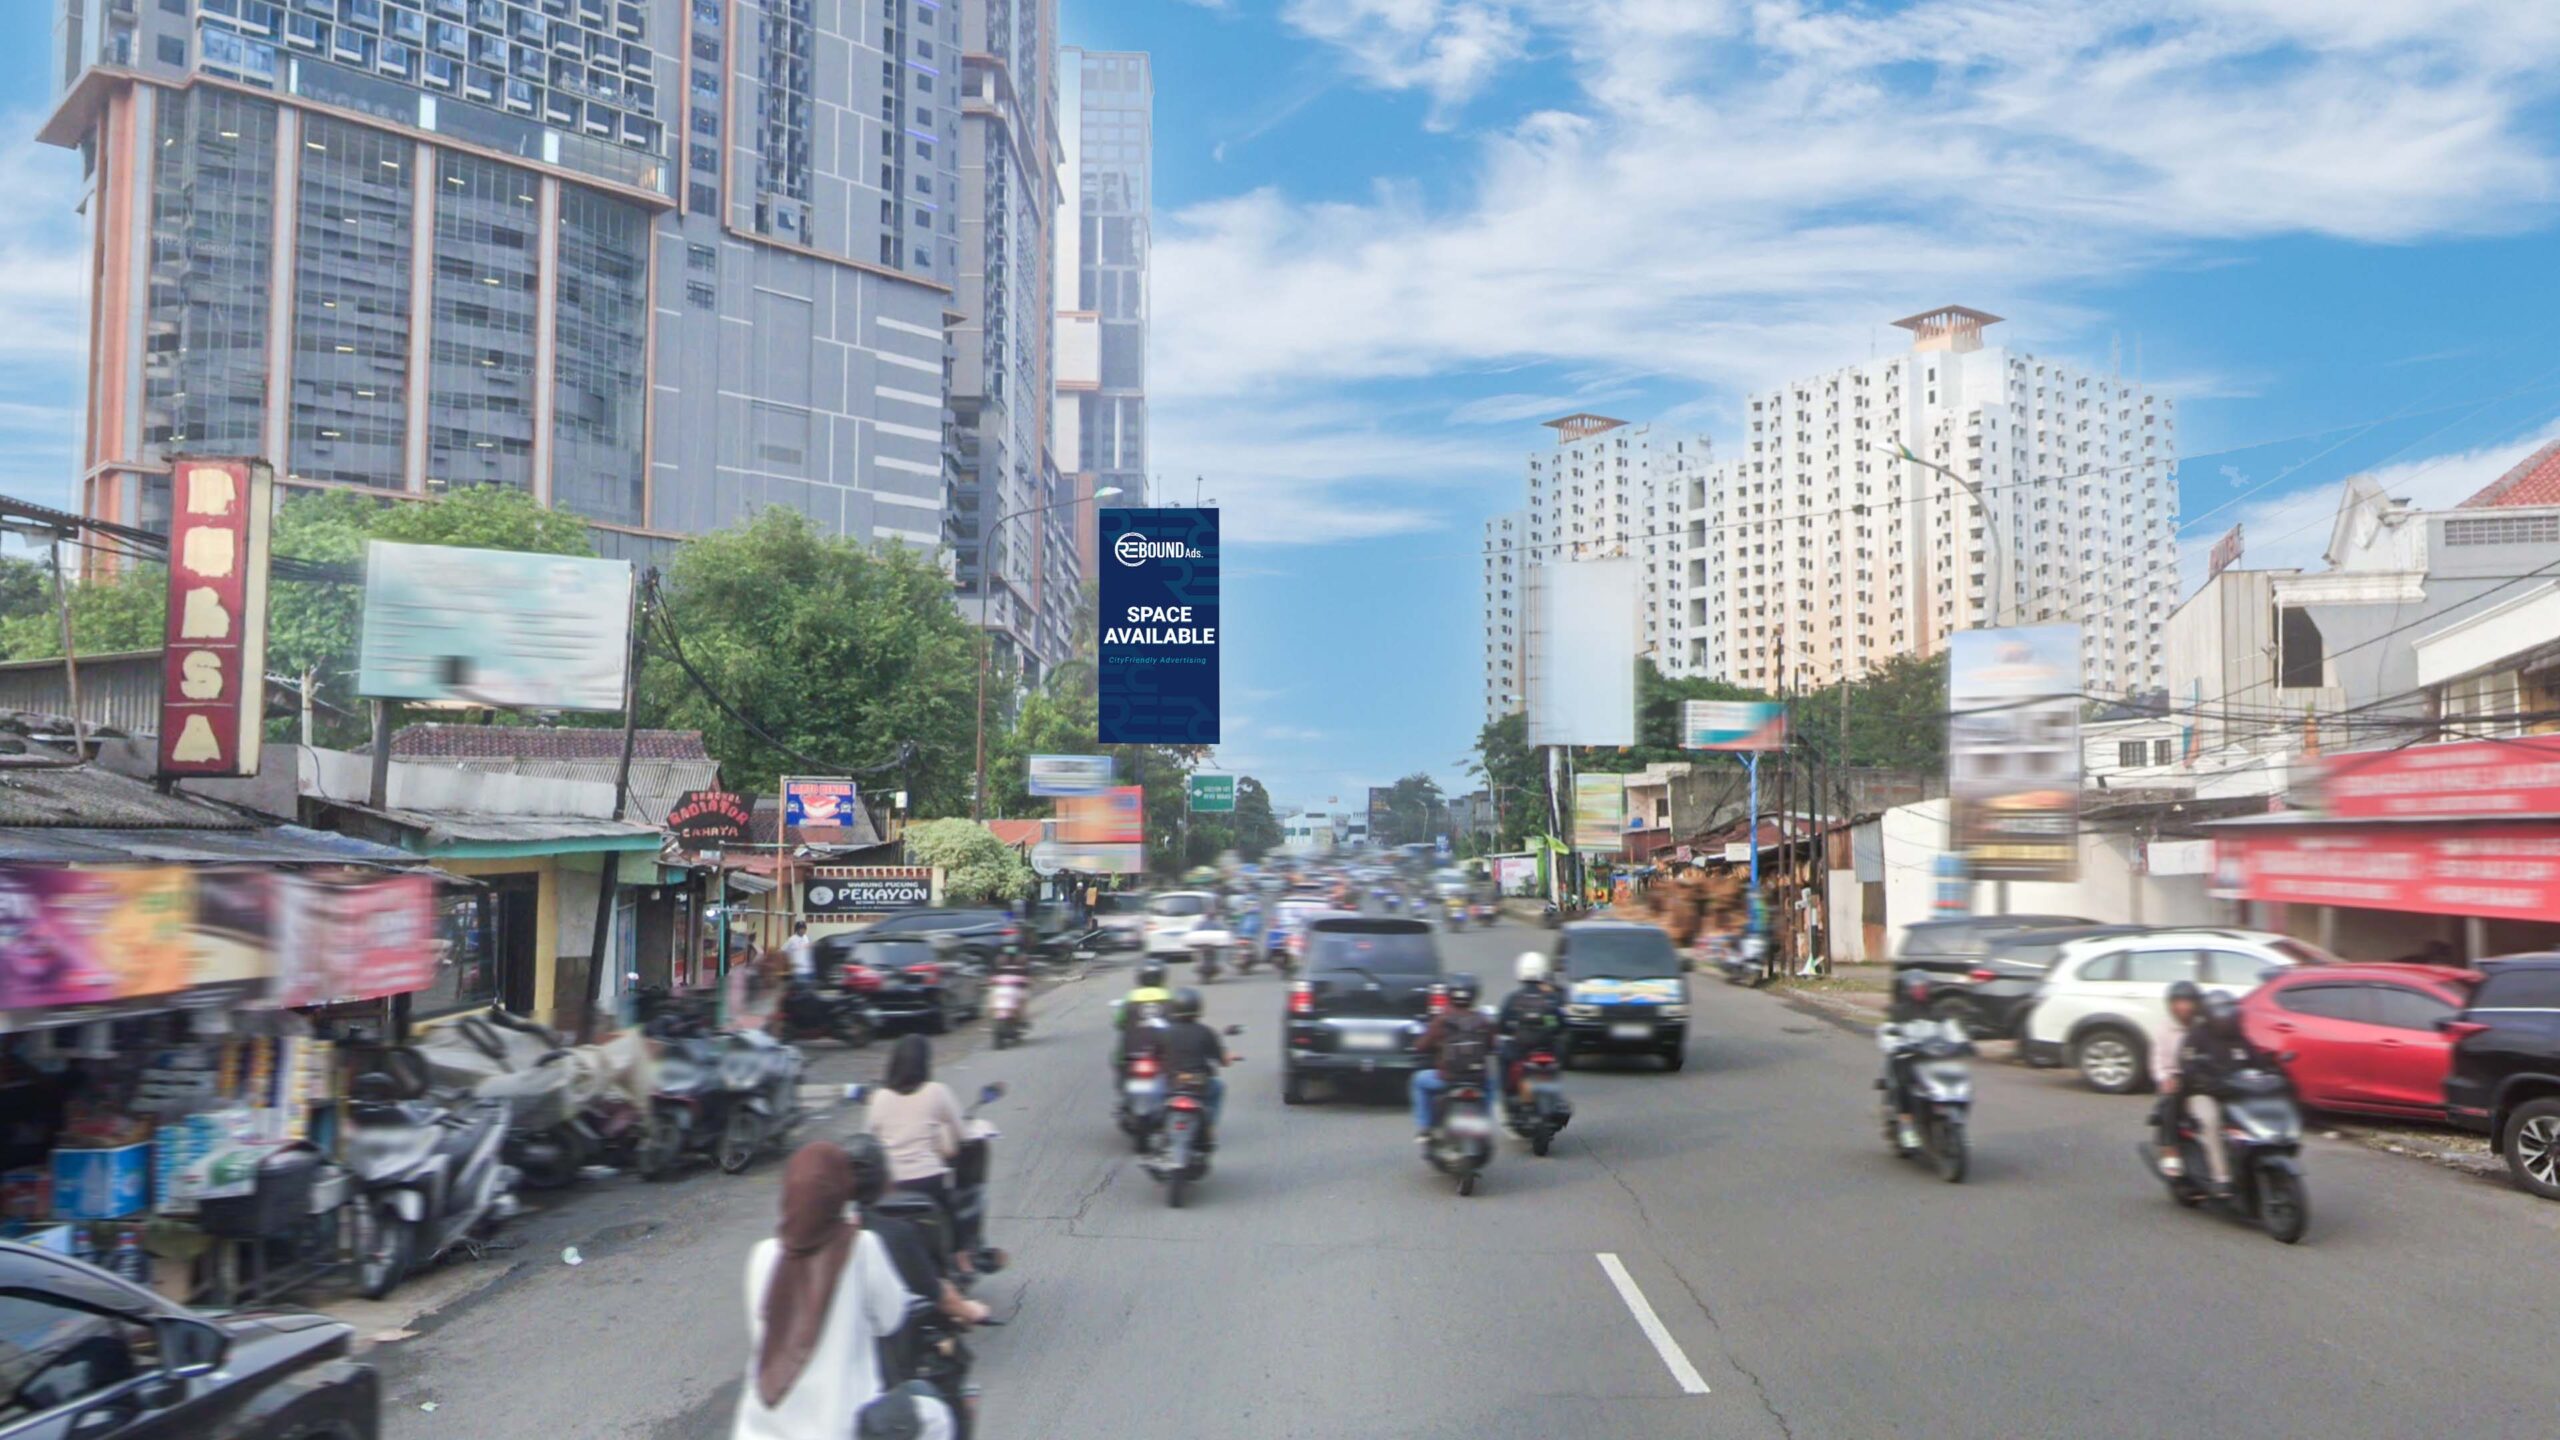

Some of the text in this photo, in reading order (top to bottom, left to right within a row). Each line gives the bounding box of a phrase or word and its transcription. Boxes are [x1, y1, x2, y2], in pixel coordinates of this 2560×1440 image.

[1185, 547, 1204, 559] Ads.
[1127, 606, 1193, 623] SPACE
[1103, 627, 1216, 645] AVAILABLE
[1108, 656, 1207, 665] CityFriendly Advertising
[667, 799, 750, 827] RADIATOR
[682, 824, 740, 838] CAHAYA
[837, 888, 928, 900] PEKAYON
